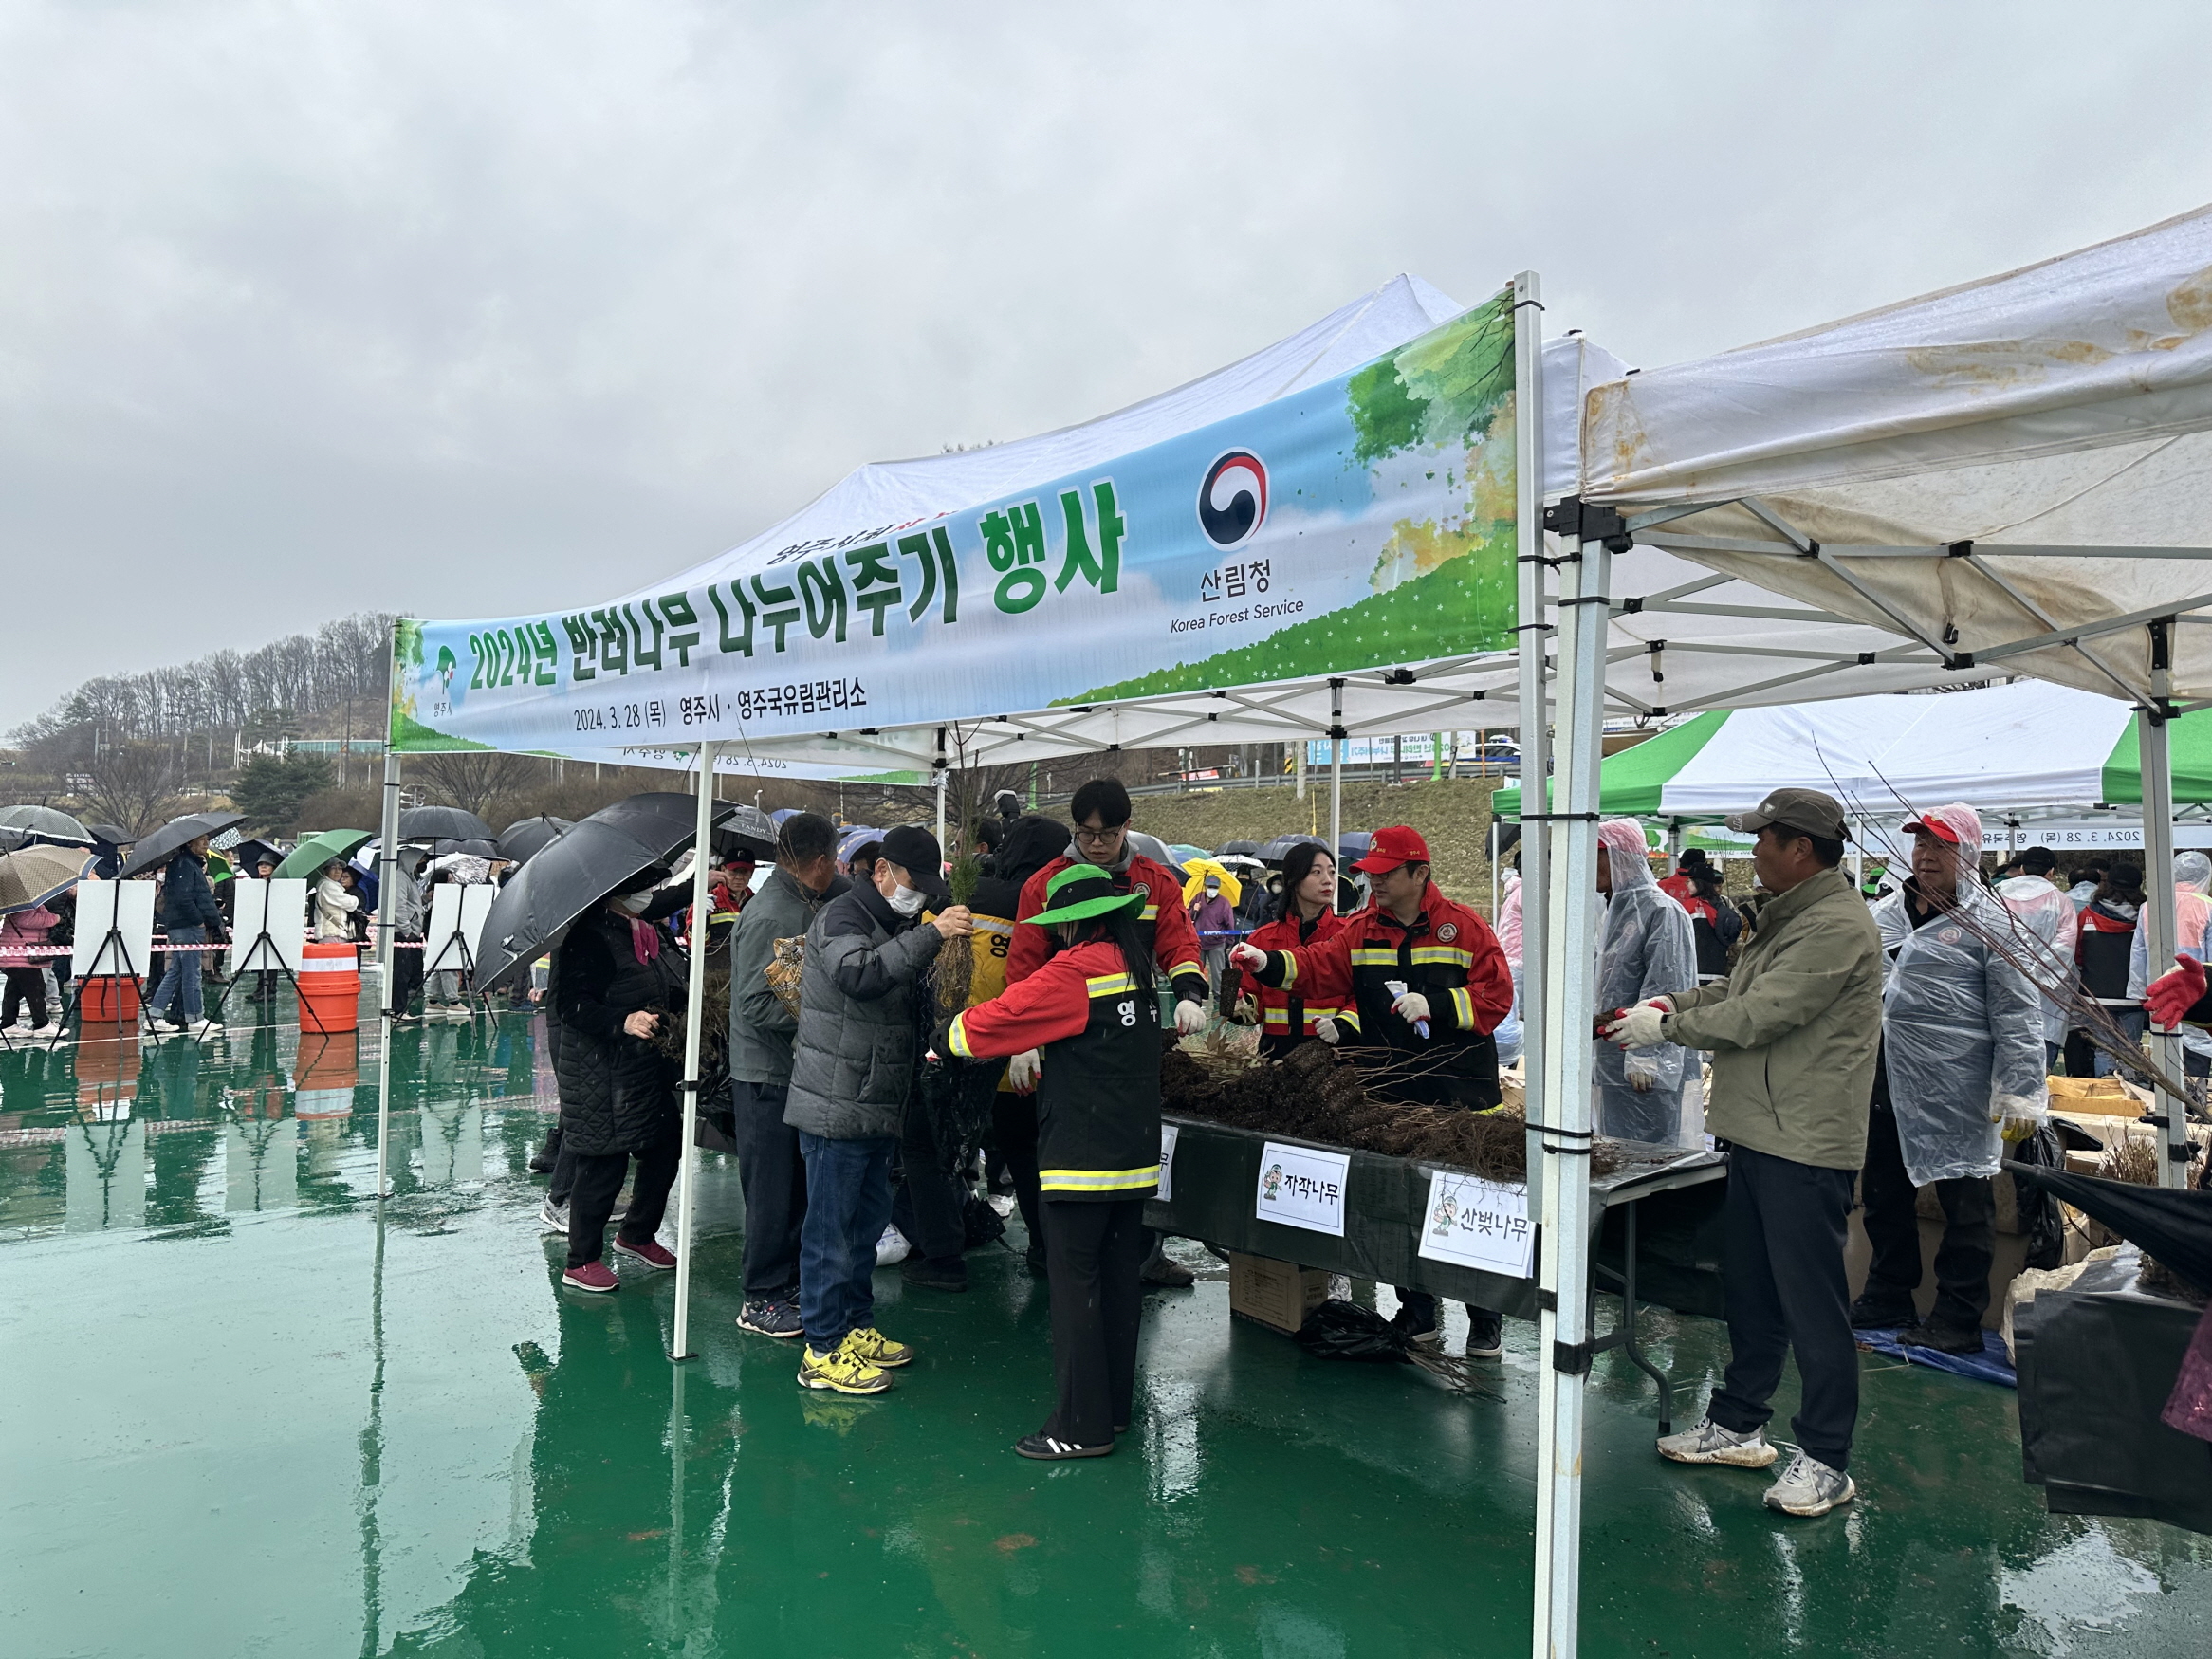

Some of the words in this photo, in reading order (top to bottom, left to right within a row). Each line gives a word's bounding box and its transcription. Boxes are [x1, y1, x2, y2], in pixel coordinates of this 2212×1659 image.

[469, 619, 558, 690] 2024년
[562, 590, 700, 681] 반려나무
[708, 525, 959, 658] 나누어주기
[979, 481, 1125, 615] 행사
[1200, 558, 1271, 602] 산림청
[1171, 618, 1206, 634] Korea
[1209, 607, 1249, 627] Forest
[1253, 599, 1304, 619] Service
[433, 701, 453, 717] 영주시
[573, 709, 607, 731] 2024.
[609, 706, 622, 728] 3.
[624, 704, 641, 728] 28
[644, 699, 666, 728] (목)
[679, 693, 721, 726] 영주시
[737, 676, 867, 720] 영주국유림관리소
[1284, 1174, 1338, 1206] 자작나무
[1460, 1207, 1528, 1243] 산벚나무
